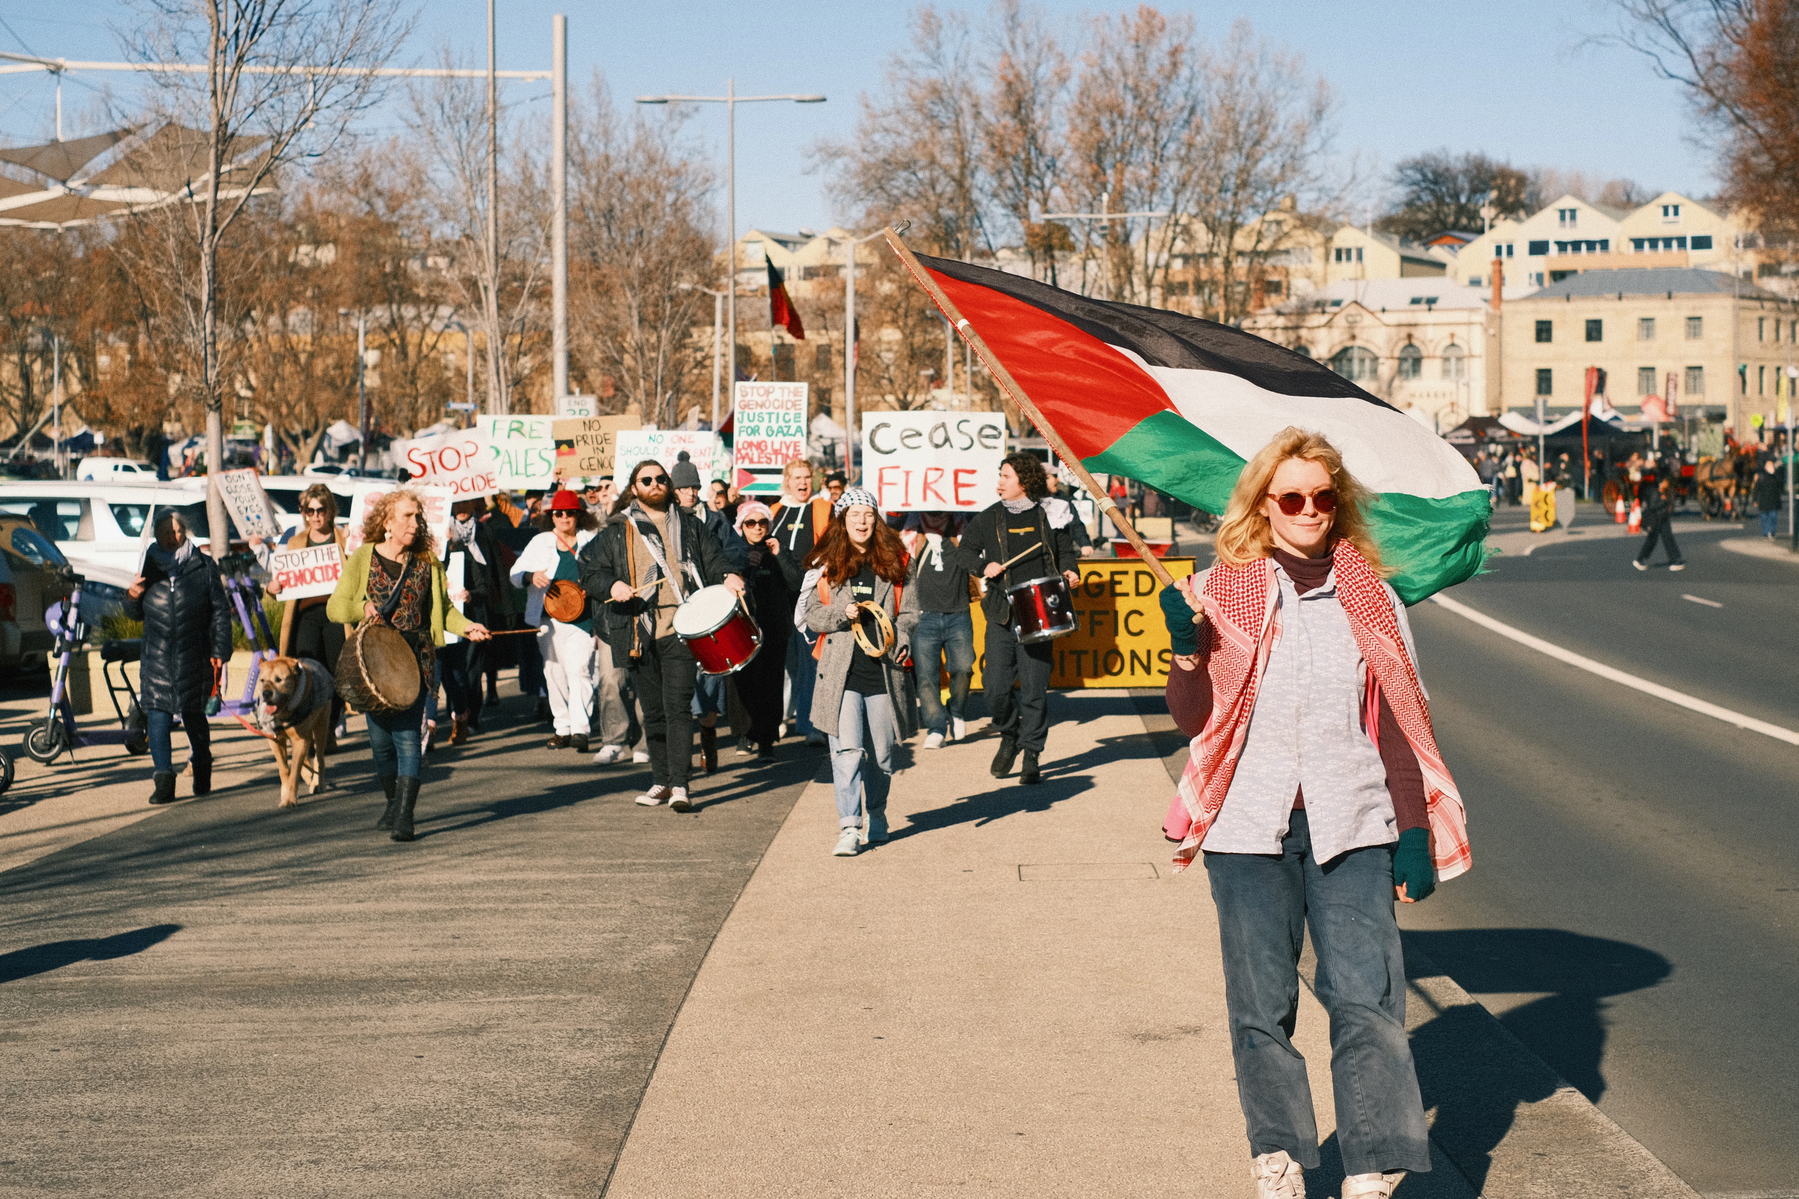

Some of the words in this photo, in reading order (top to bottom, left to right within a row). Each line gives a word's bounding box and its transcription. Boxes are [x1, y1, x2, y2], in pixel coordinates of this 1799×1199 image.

[739, 385, 775, 398] STOP
[778, 386, 804, 398] THE
[738, 399, 803, 411] GENOCIDE
[737, 411, 802, 424] JUSTICE
[492, 419, 553, 439] FRE
[582, 420, 601, 431] NO
[738, 425, 761, 437] FOR
[766, 425, 804, 437] GAZA
[575, 433, 612, 446] PRIDE
[648, 434, 664, 444] NO
[671, 434, 695, 444] ONE
[593, 446, 604, 454] IN
[619, 445, 659, 456] SHOULD
[665, 446, 676, 457] BE
[735, 440, 768, 453] LONG
[771, 440, 802, 453] LIVE
[407, 440, 479, 478] STOP
[877, 465, 978, 508] FIRE
[232, 493, 256, 504] YOUR
[237, 504, 263, 515] EYES
[274, 550, 309, 570] STOP
[310, 545, 339, 562] THE
[275, 563, 340, 589] GENOCIDE
